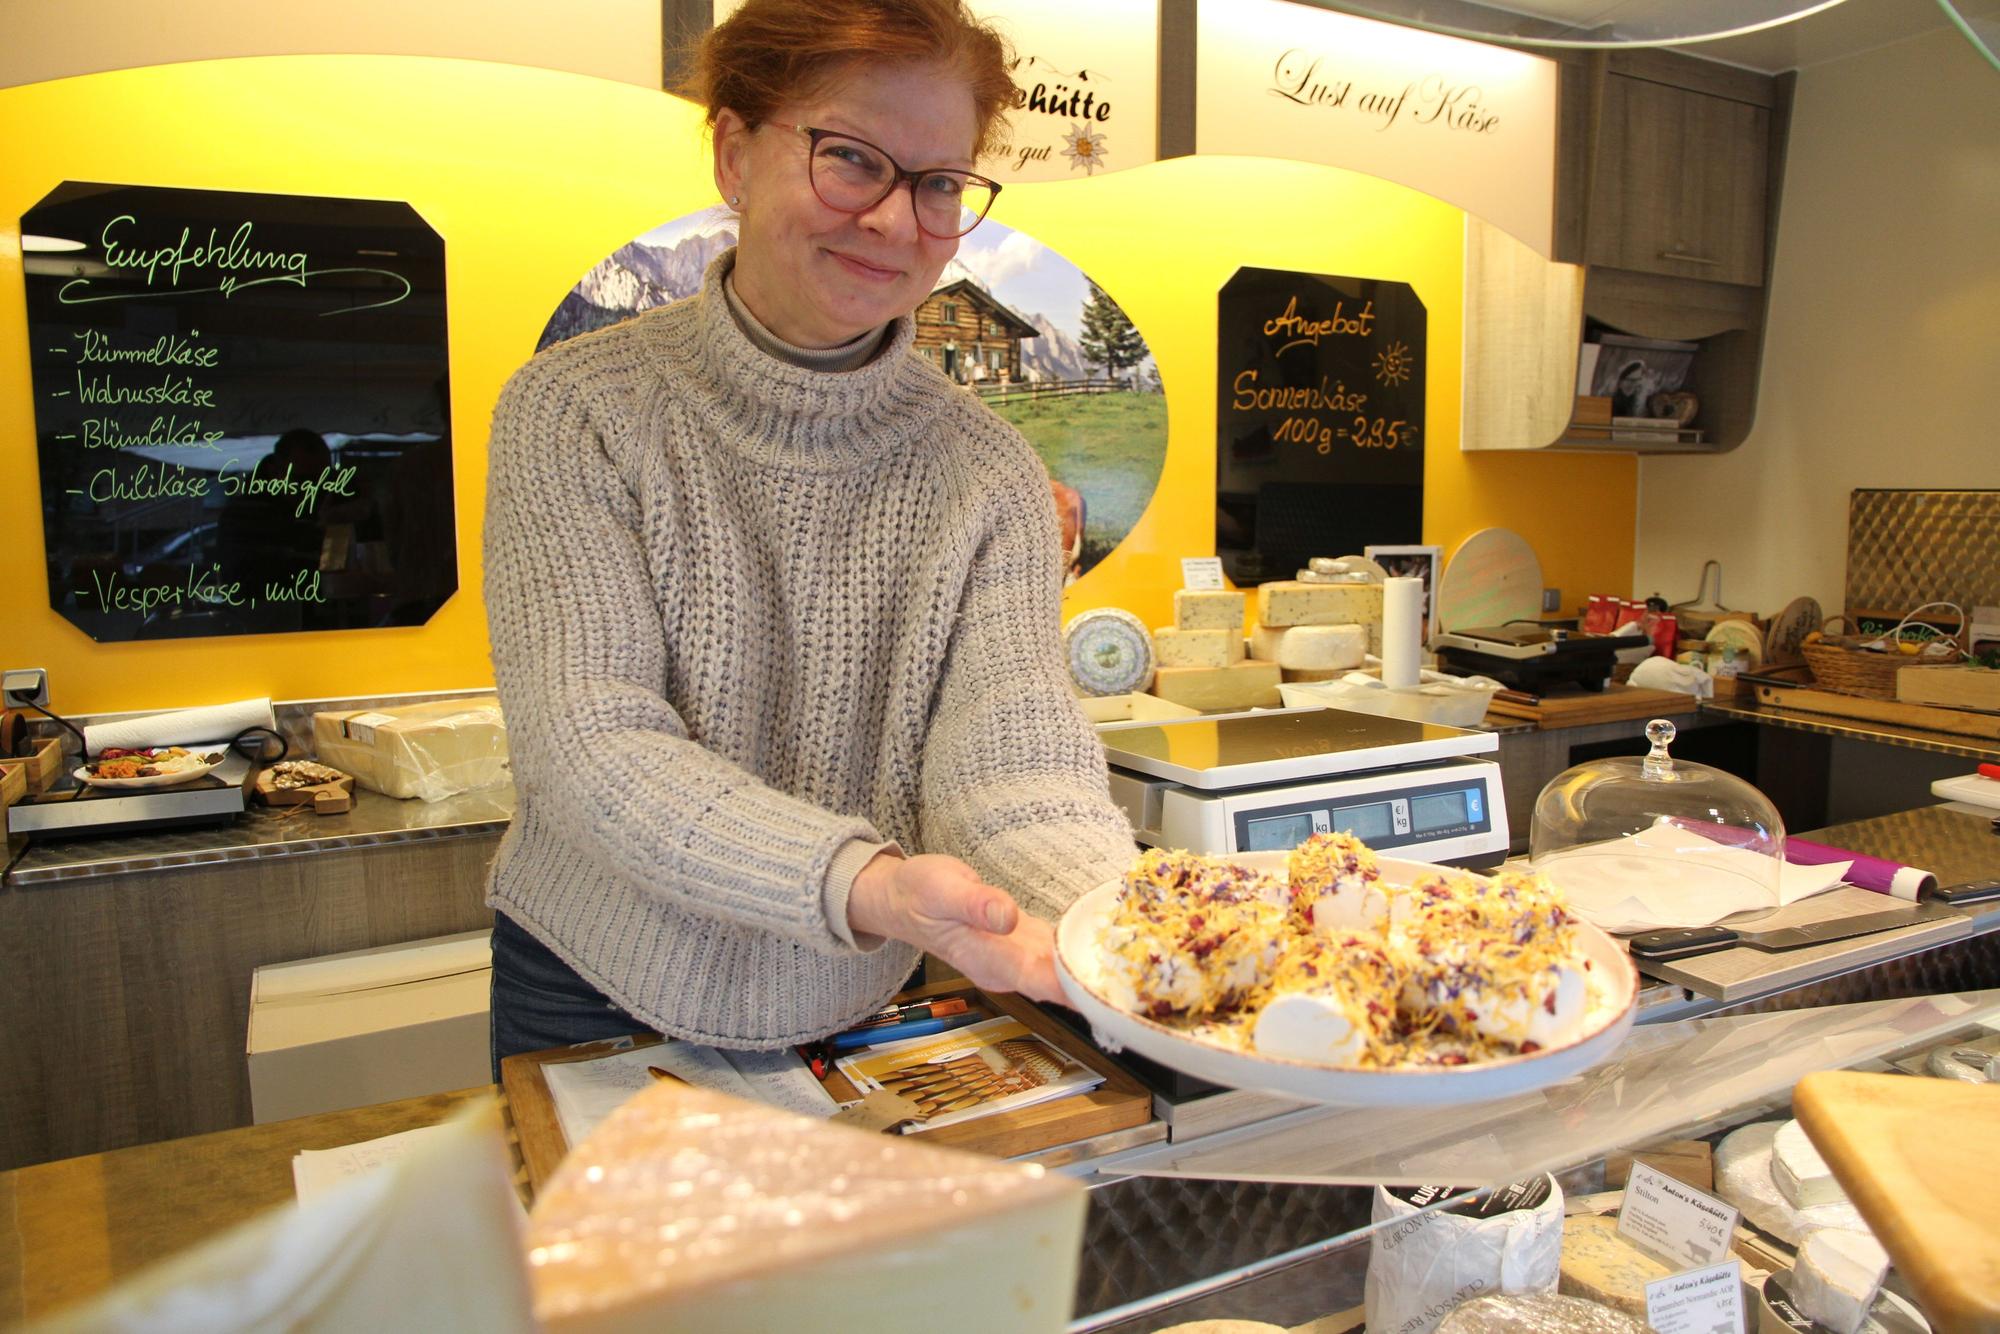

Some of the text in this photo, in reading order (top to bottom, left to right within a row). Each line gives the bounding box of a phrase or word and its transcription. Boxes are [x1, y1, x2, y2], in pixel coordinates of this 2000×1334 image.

[1013, 83, 1111, 121] ehütte
[1267, 48, 1500, 134] Lust auf Käse
[1011, 145, 1052, 172] gut
[102, 215, 307, 288] Empfehlung
[1264, 296, 1375, 348] Angebot
[1232, 370, 1368, 412] Sonnenkäse
[89, 462, 211, 502] Chilikäse
[265, 569, 327, 603] mild
[1634, 1185, 1659, 1205] Stilton
